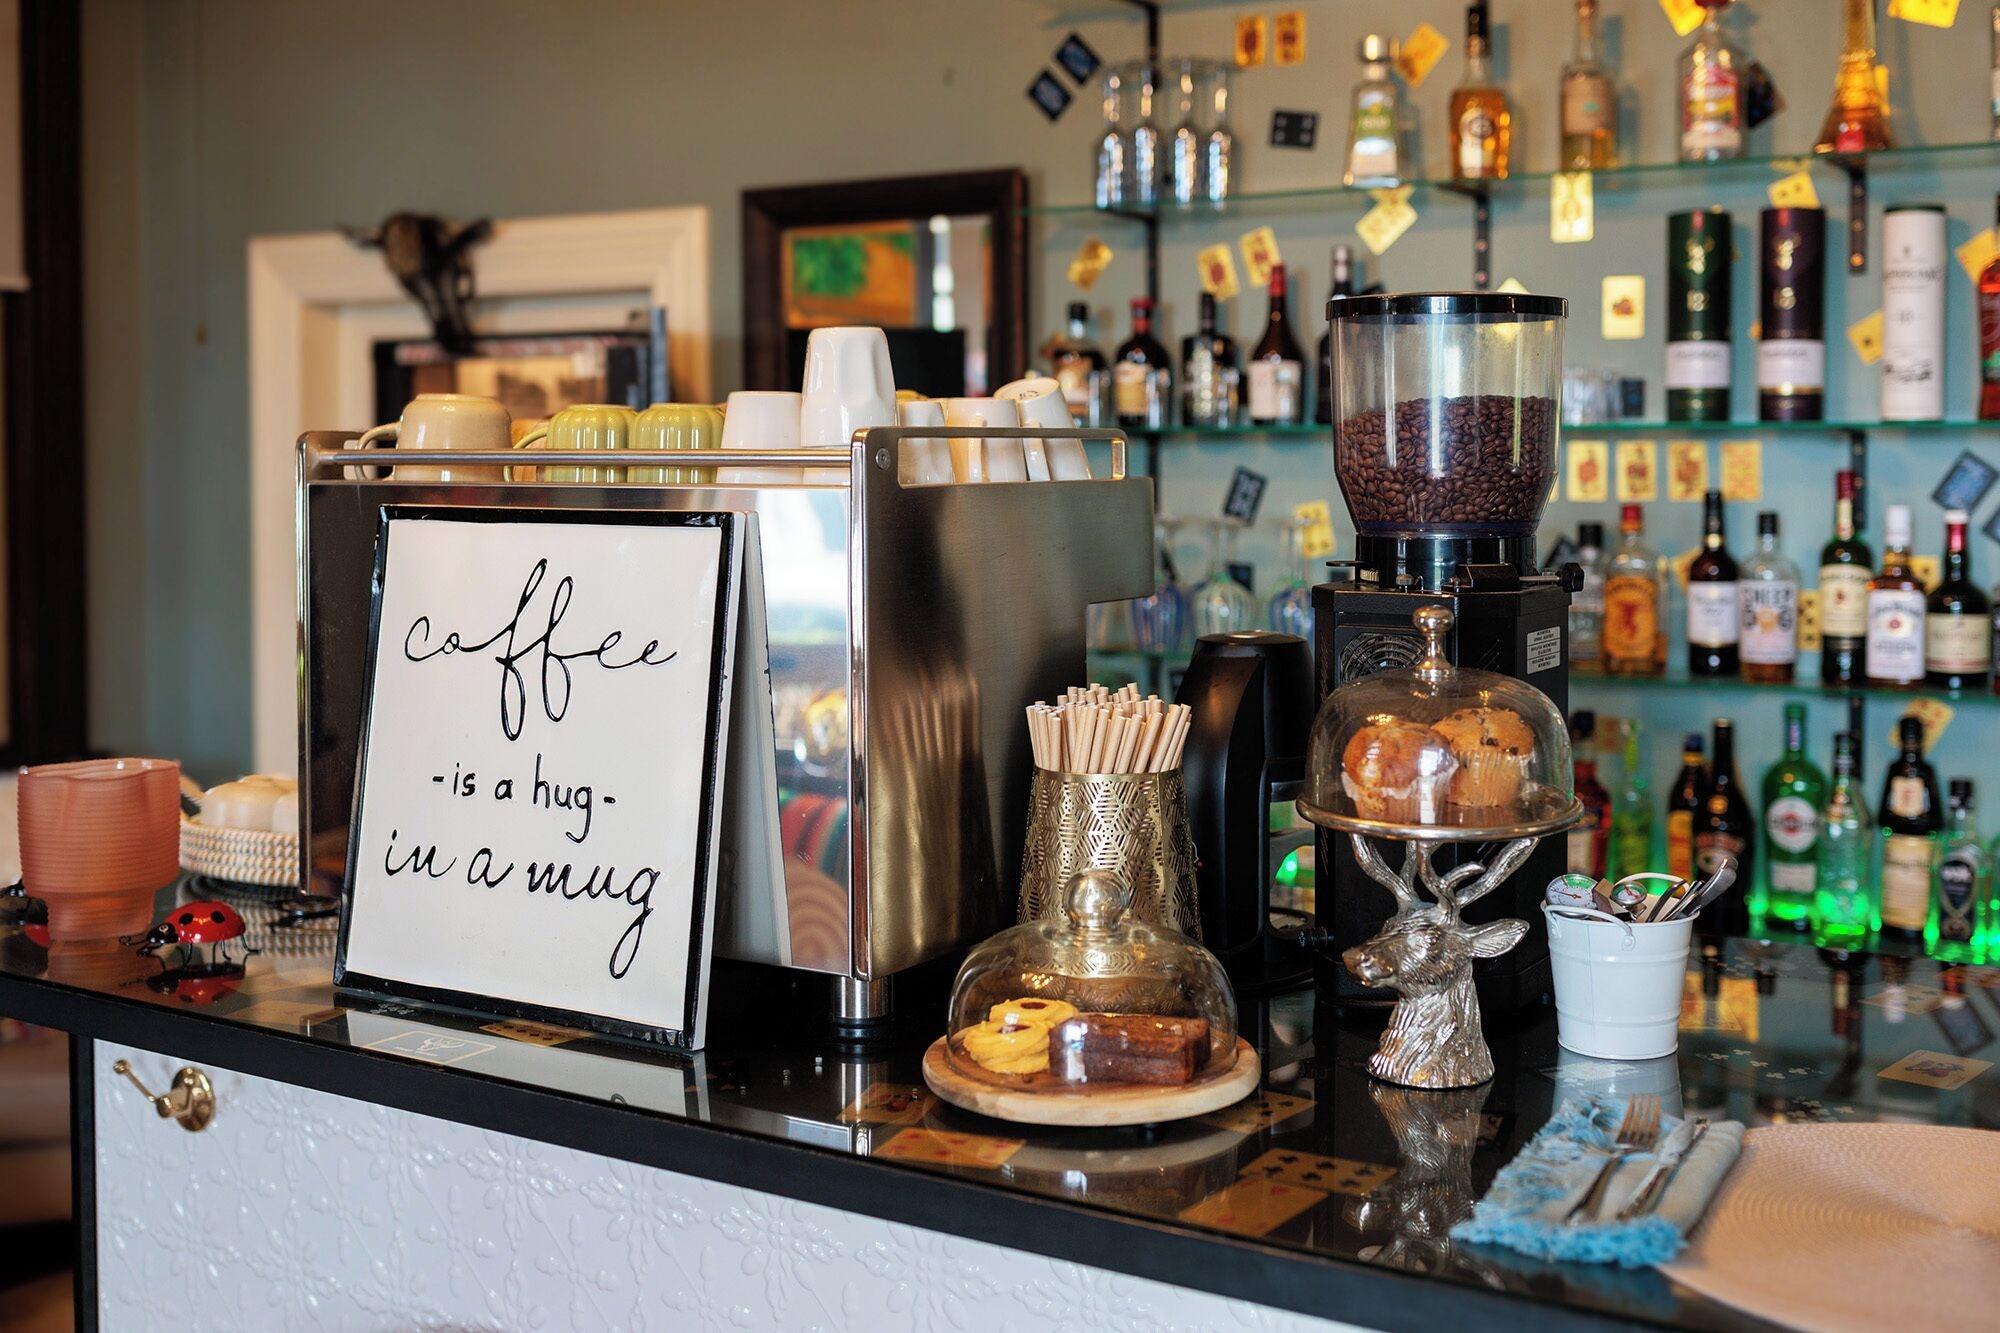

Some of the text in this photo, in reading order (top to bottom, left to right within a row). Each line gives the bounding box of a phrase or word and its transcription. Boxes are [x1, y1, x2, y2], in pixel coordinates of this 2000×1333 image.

[405, 557, 678, 741] coffee
[494, 778, 514, 801] a
[385, 828, 662, 980] in a mug
